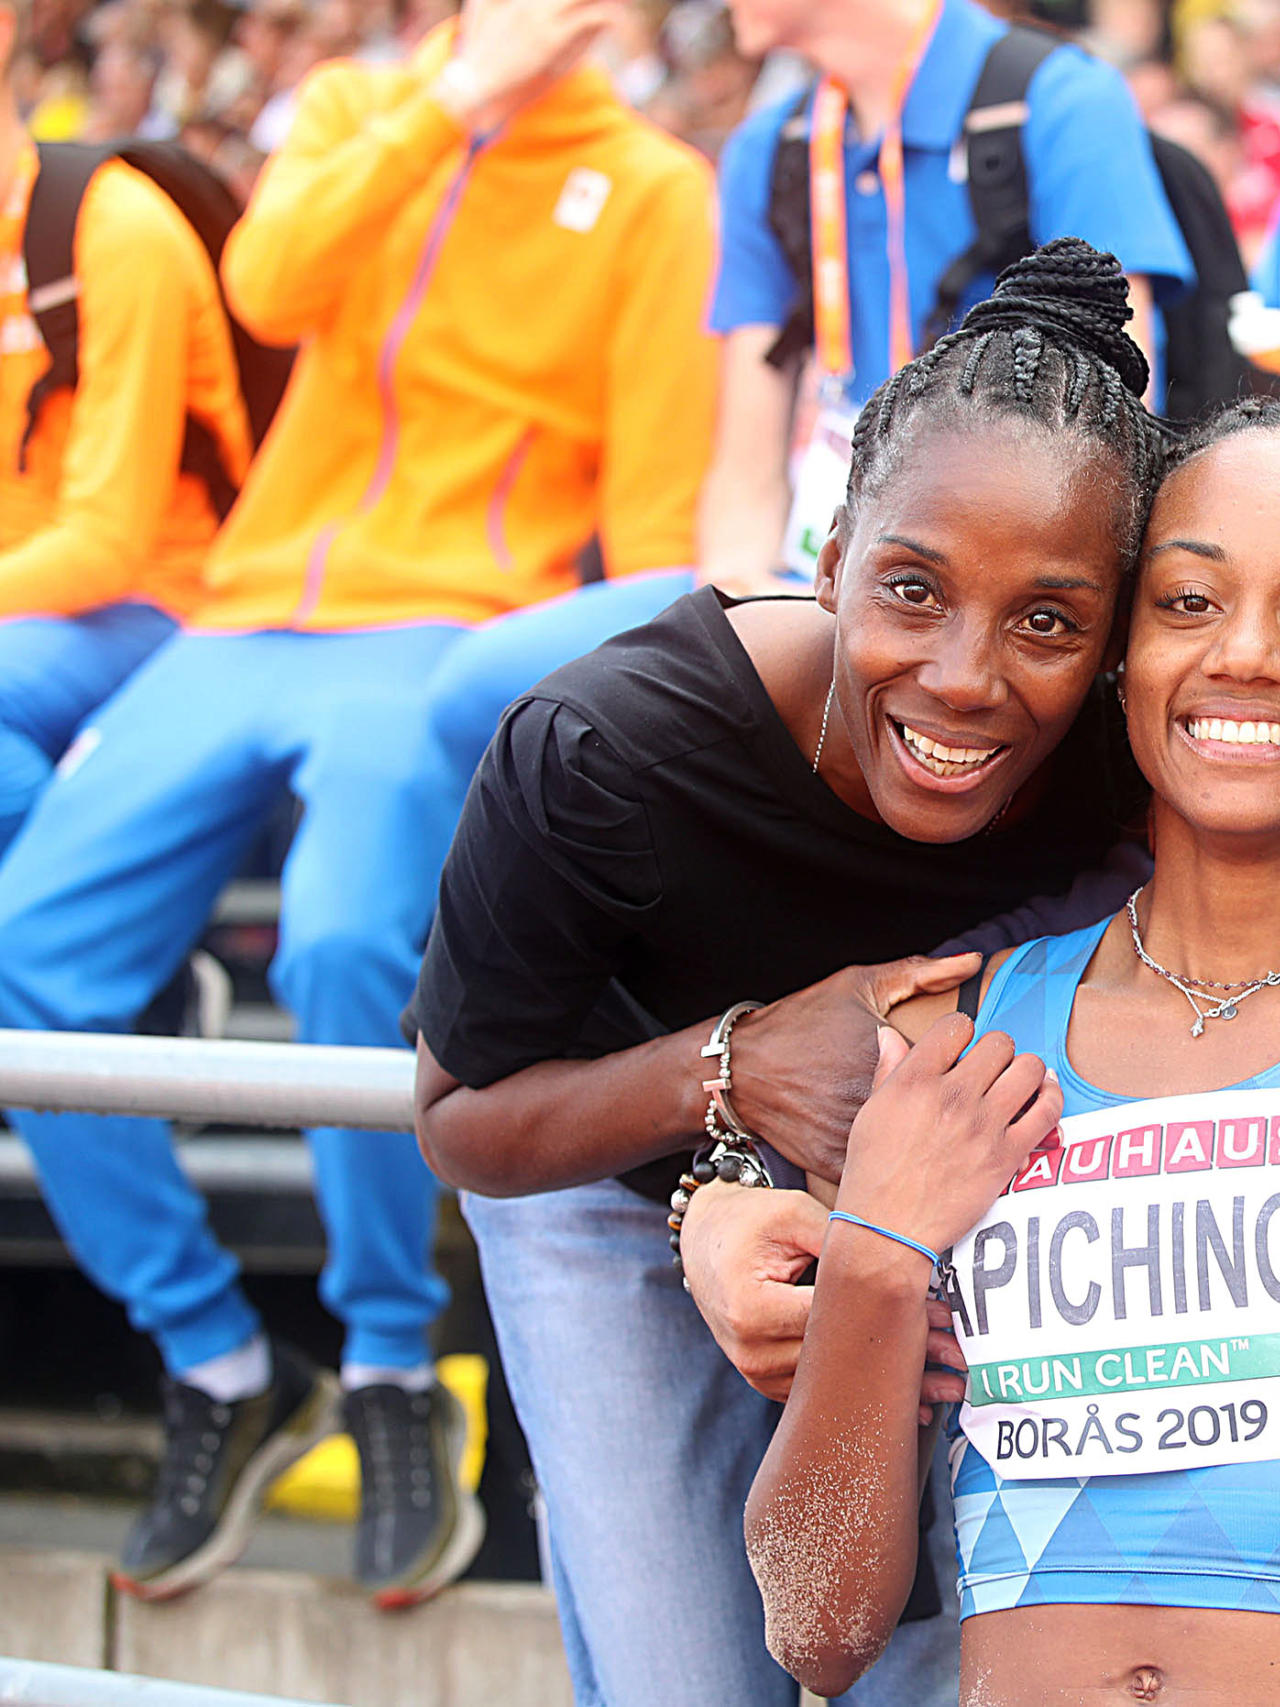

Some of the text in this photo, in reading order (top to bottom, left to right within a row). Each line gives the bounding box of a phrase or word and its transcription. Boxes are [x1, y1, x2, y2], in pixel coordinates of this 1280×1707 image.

[981, 1369, 994, 1398] I
[998, 1357, 1083, 1398] RUN
[997, 1400, 1268, 1460] BORÅS 2019
